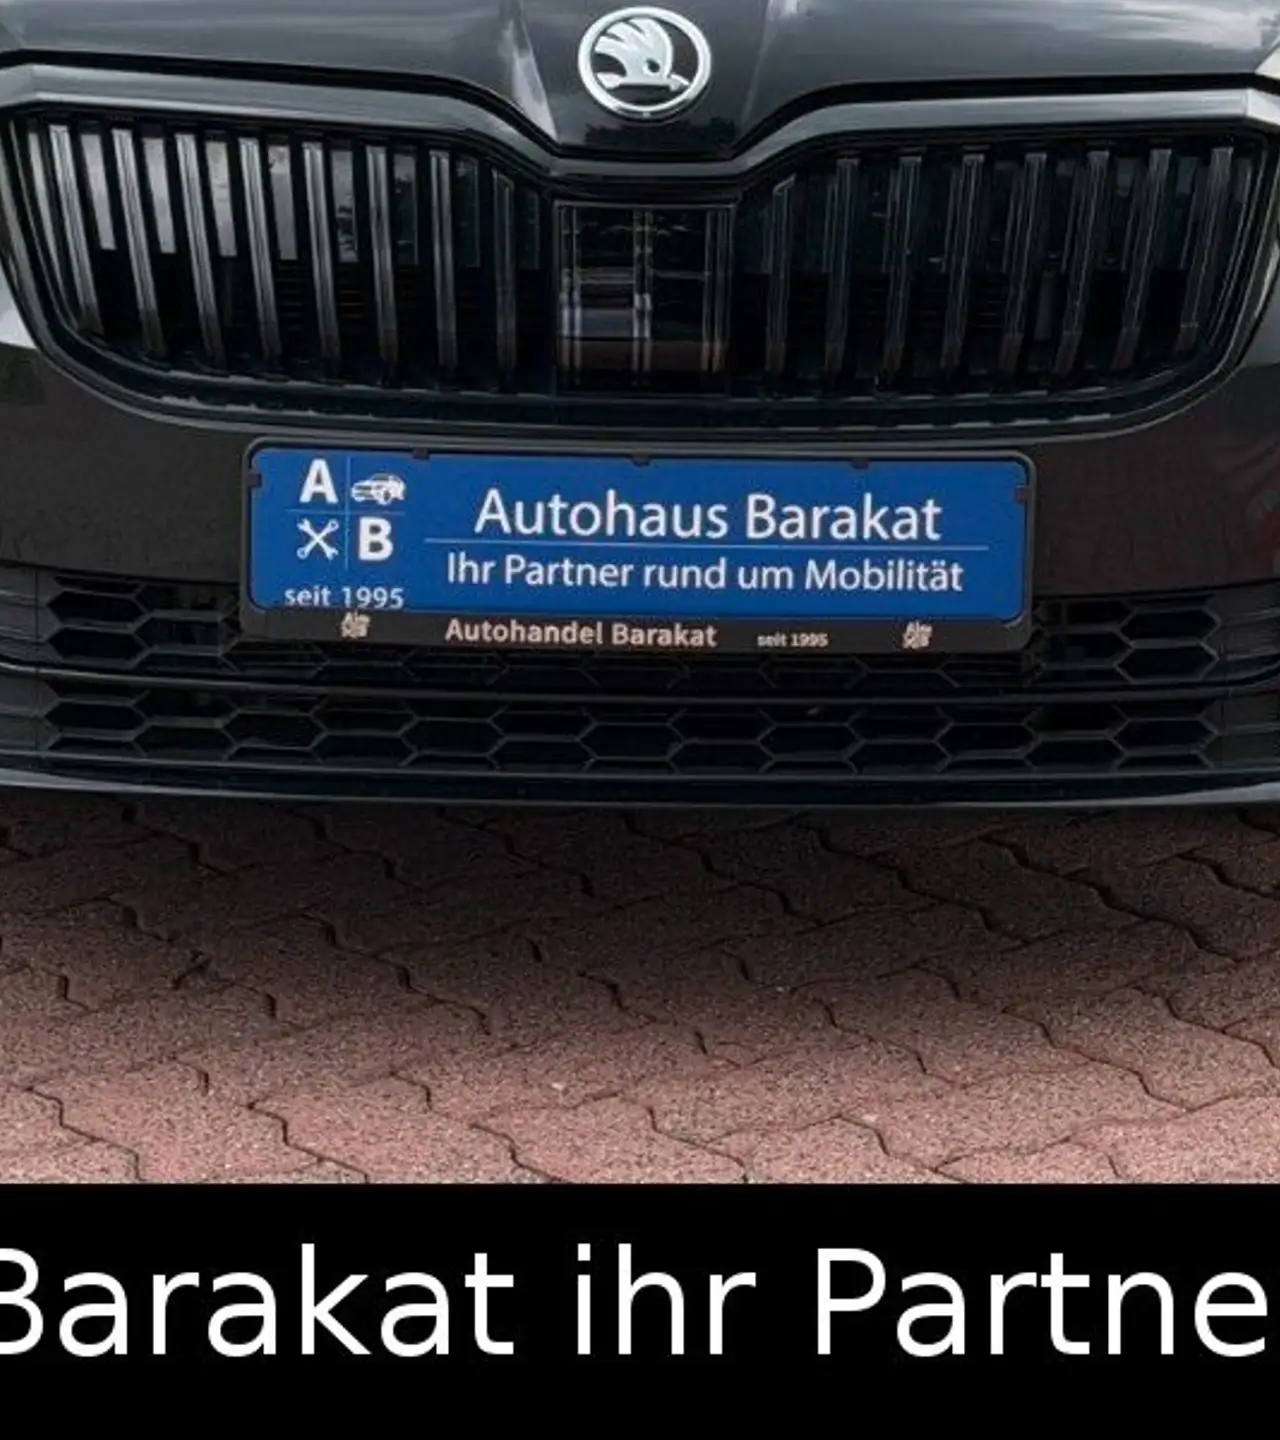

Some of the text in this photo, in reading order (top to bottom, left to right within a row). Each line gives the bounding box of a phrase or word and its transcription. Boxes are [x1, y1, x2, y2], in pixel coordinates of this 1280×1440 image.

[298, 457, 339, 505] A
[473, 487, 943, 541] Autohaus Barakat
[357, 516, 395, 562] B
[446, 552, 963, 593] Ihr Partner rund um Mobilität
[283, 586, 404, 610] seit 1995
[444, 618, 718, 648] Autohandel Barakat
[756, 631, 829, 648] seit 1995
